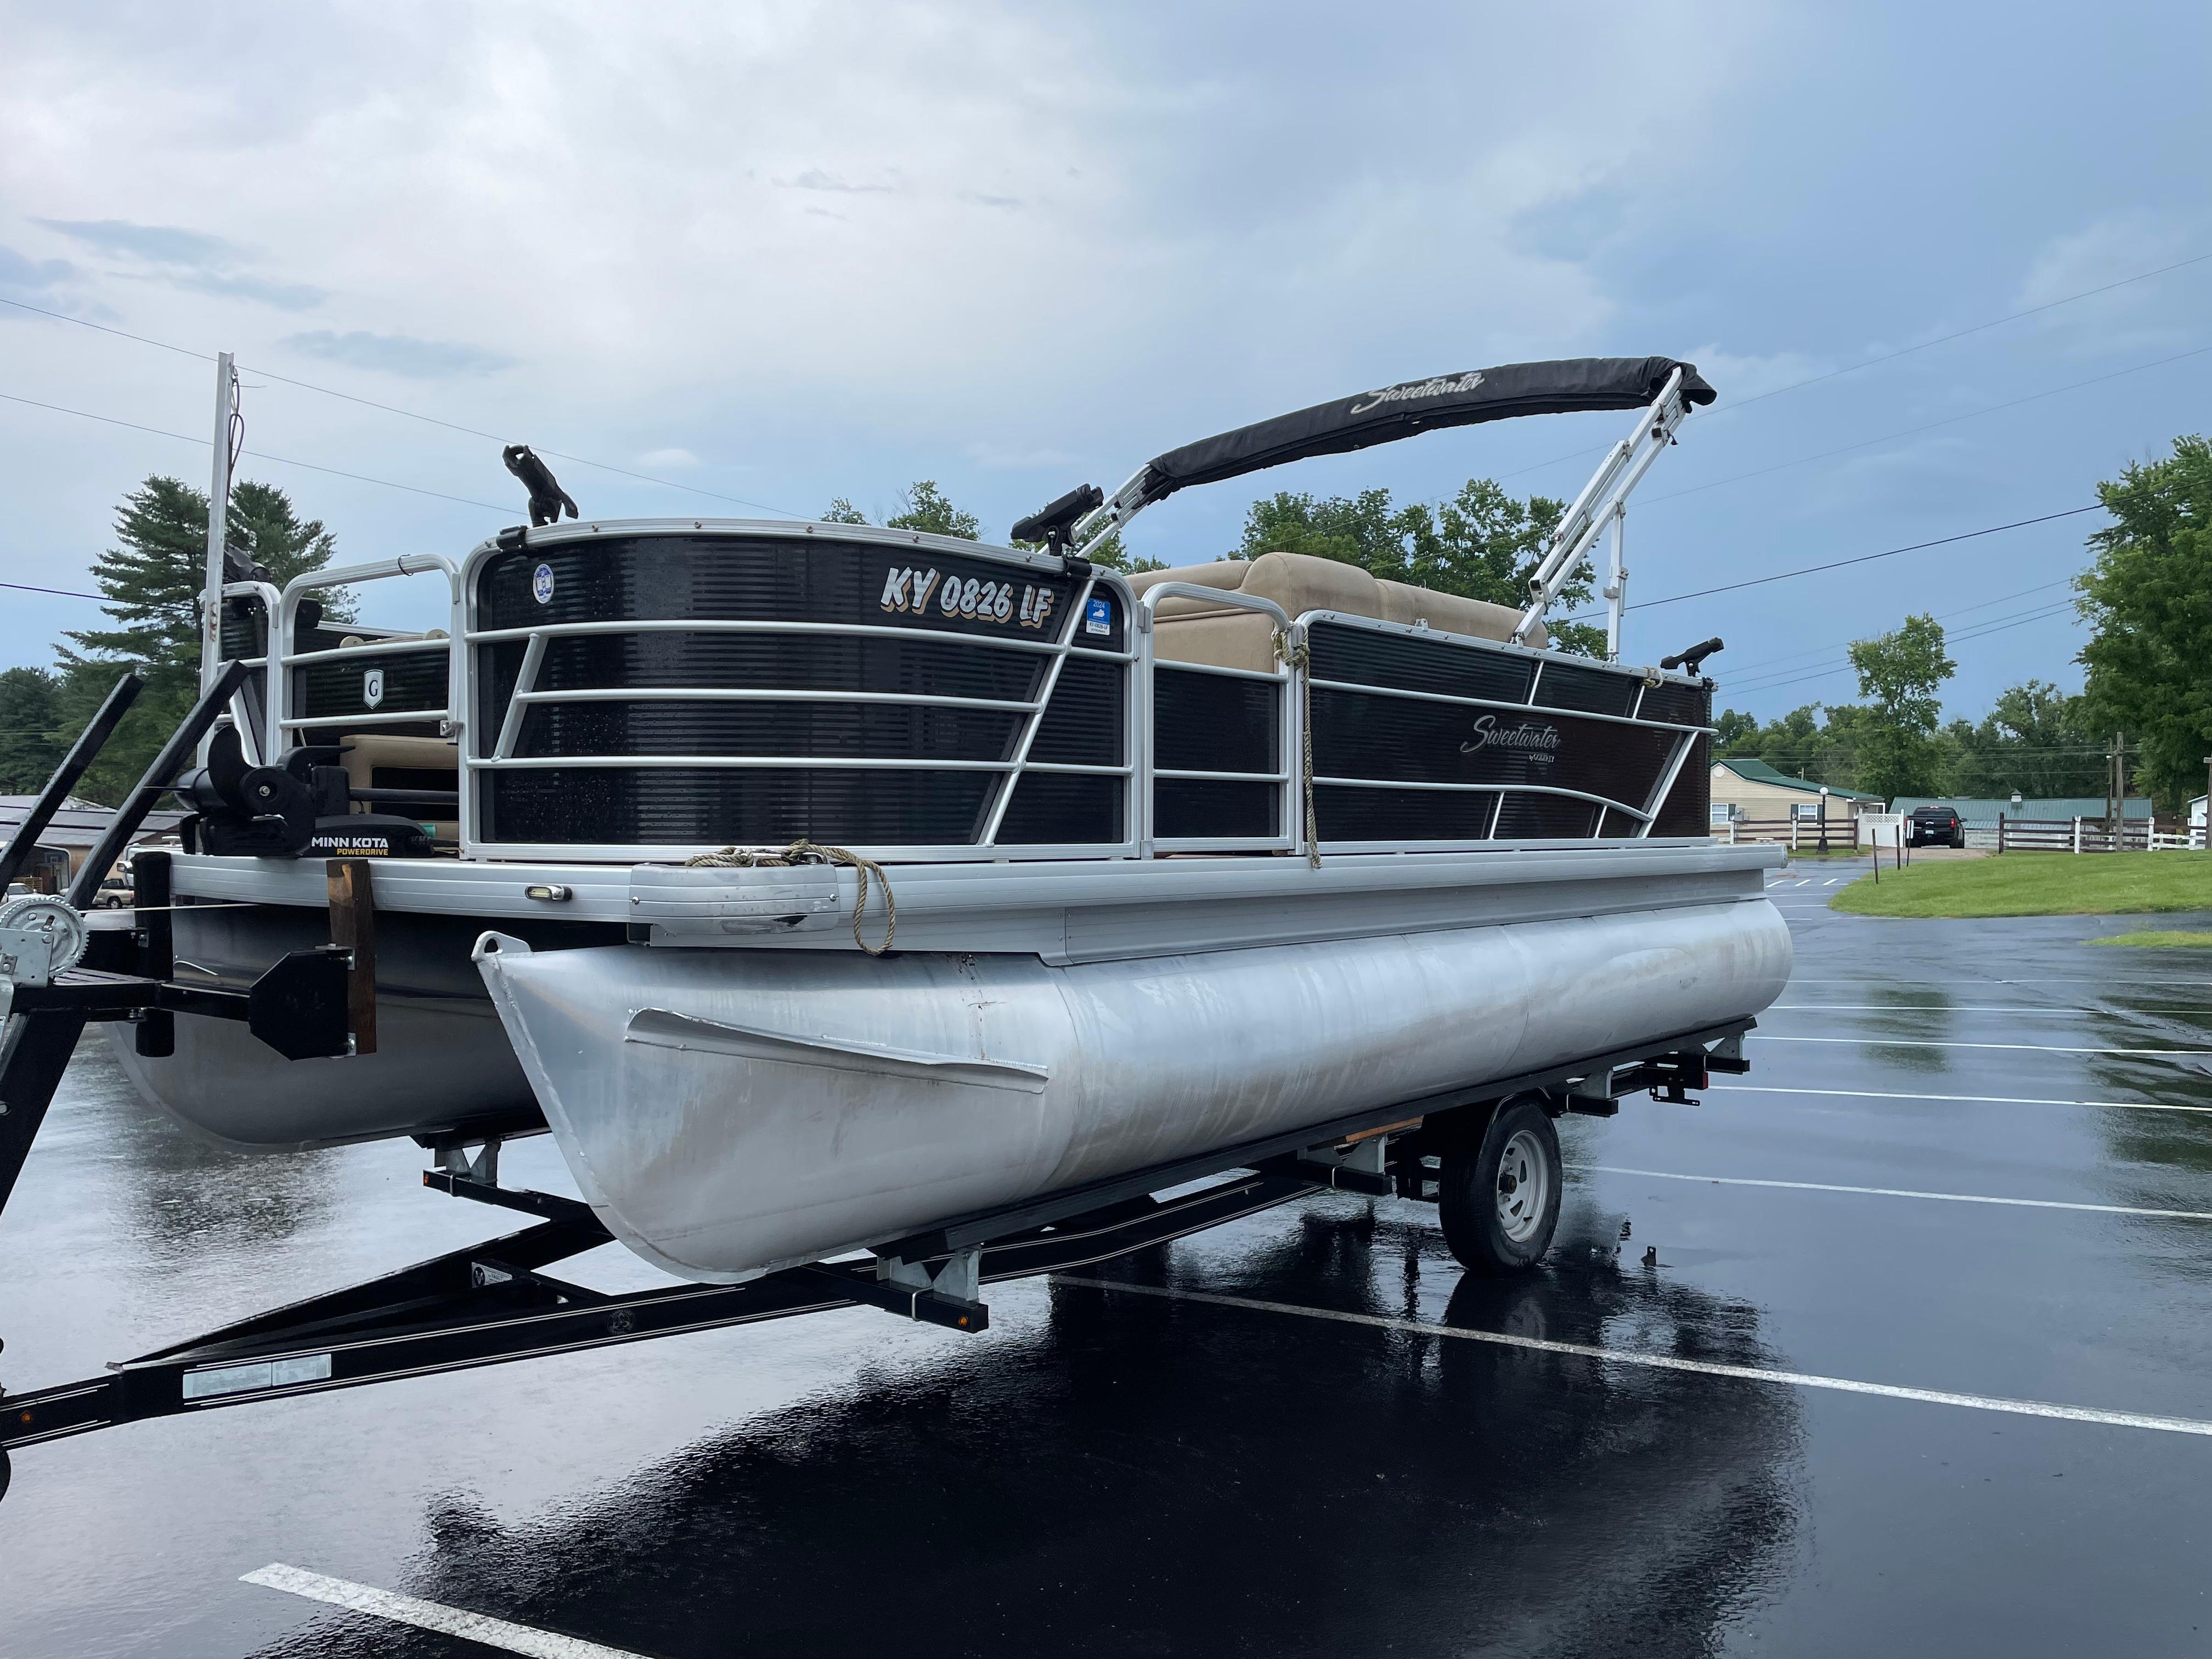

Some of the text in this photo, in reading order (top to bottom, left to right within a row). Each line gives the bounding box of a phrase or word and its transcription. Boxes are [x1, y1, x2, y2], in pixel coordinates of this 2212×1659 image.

[1350, 373, 1485, 415] Sweetwater
[880, 566, 1055, 629] KY 0826 LF
[1093, 600, 1105, 609] 2024
[369, 680, 379, 697] G
[1460, 715, 1561, 753] Sweetwater
[311, 837, 389, 848] MINN KOTA
